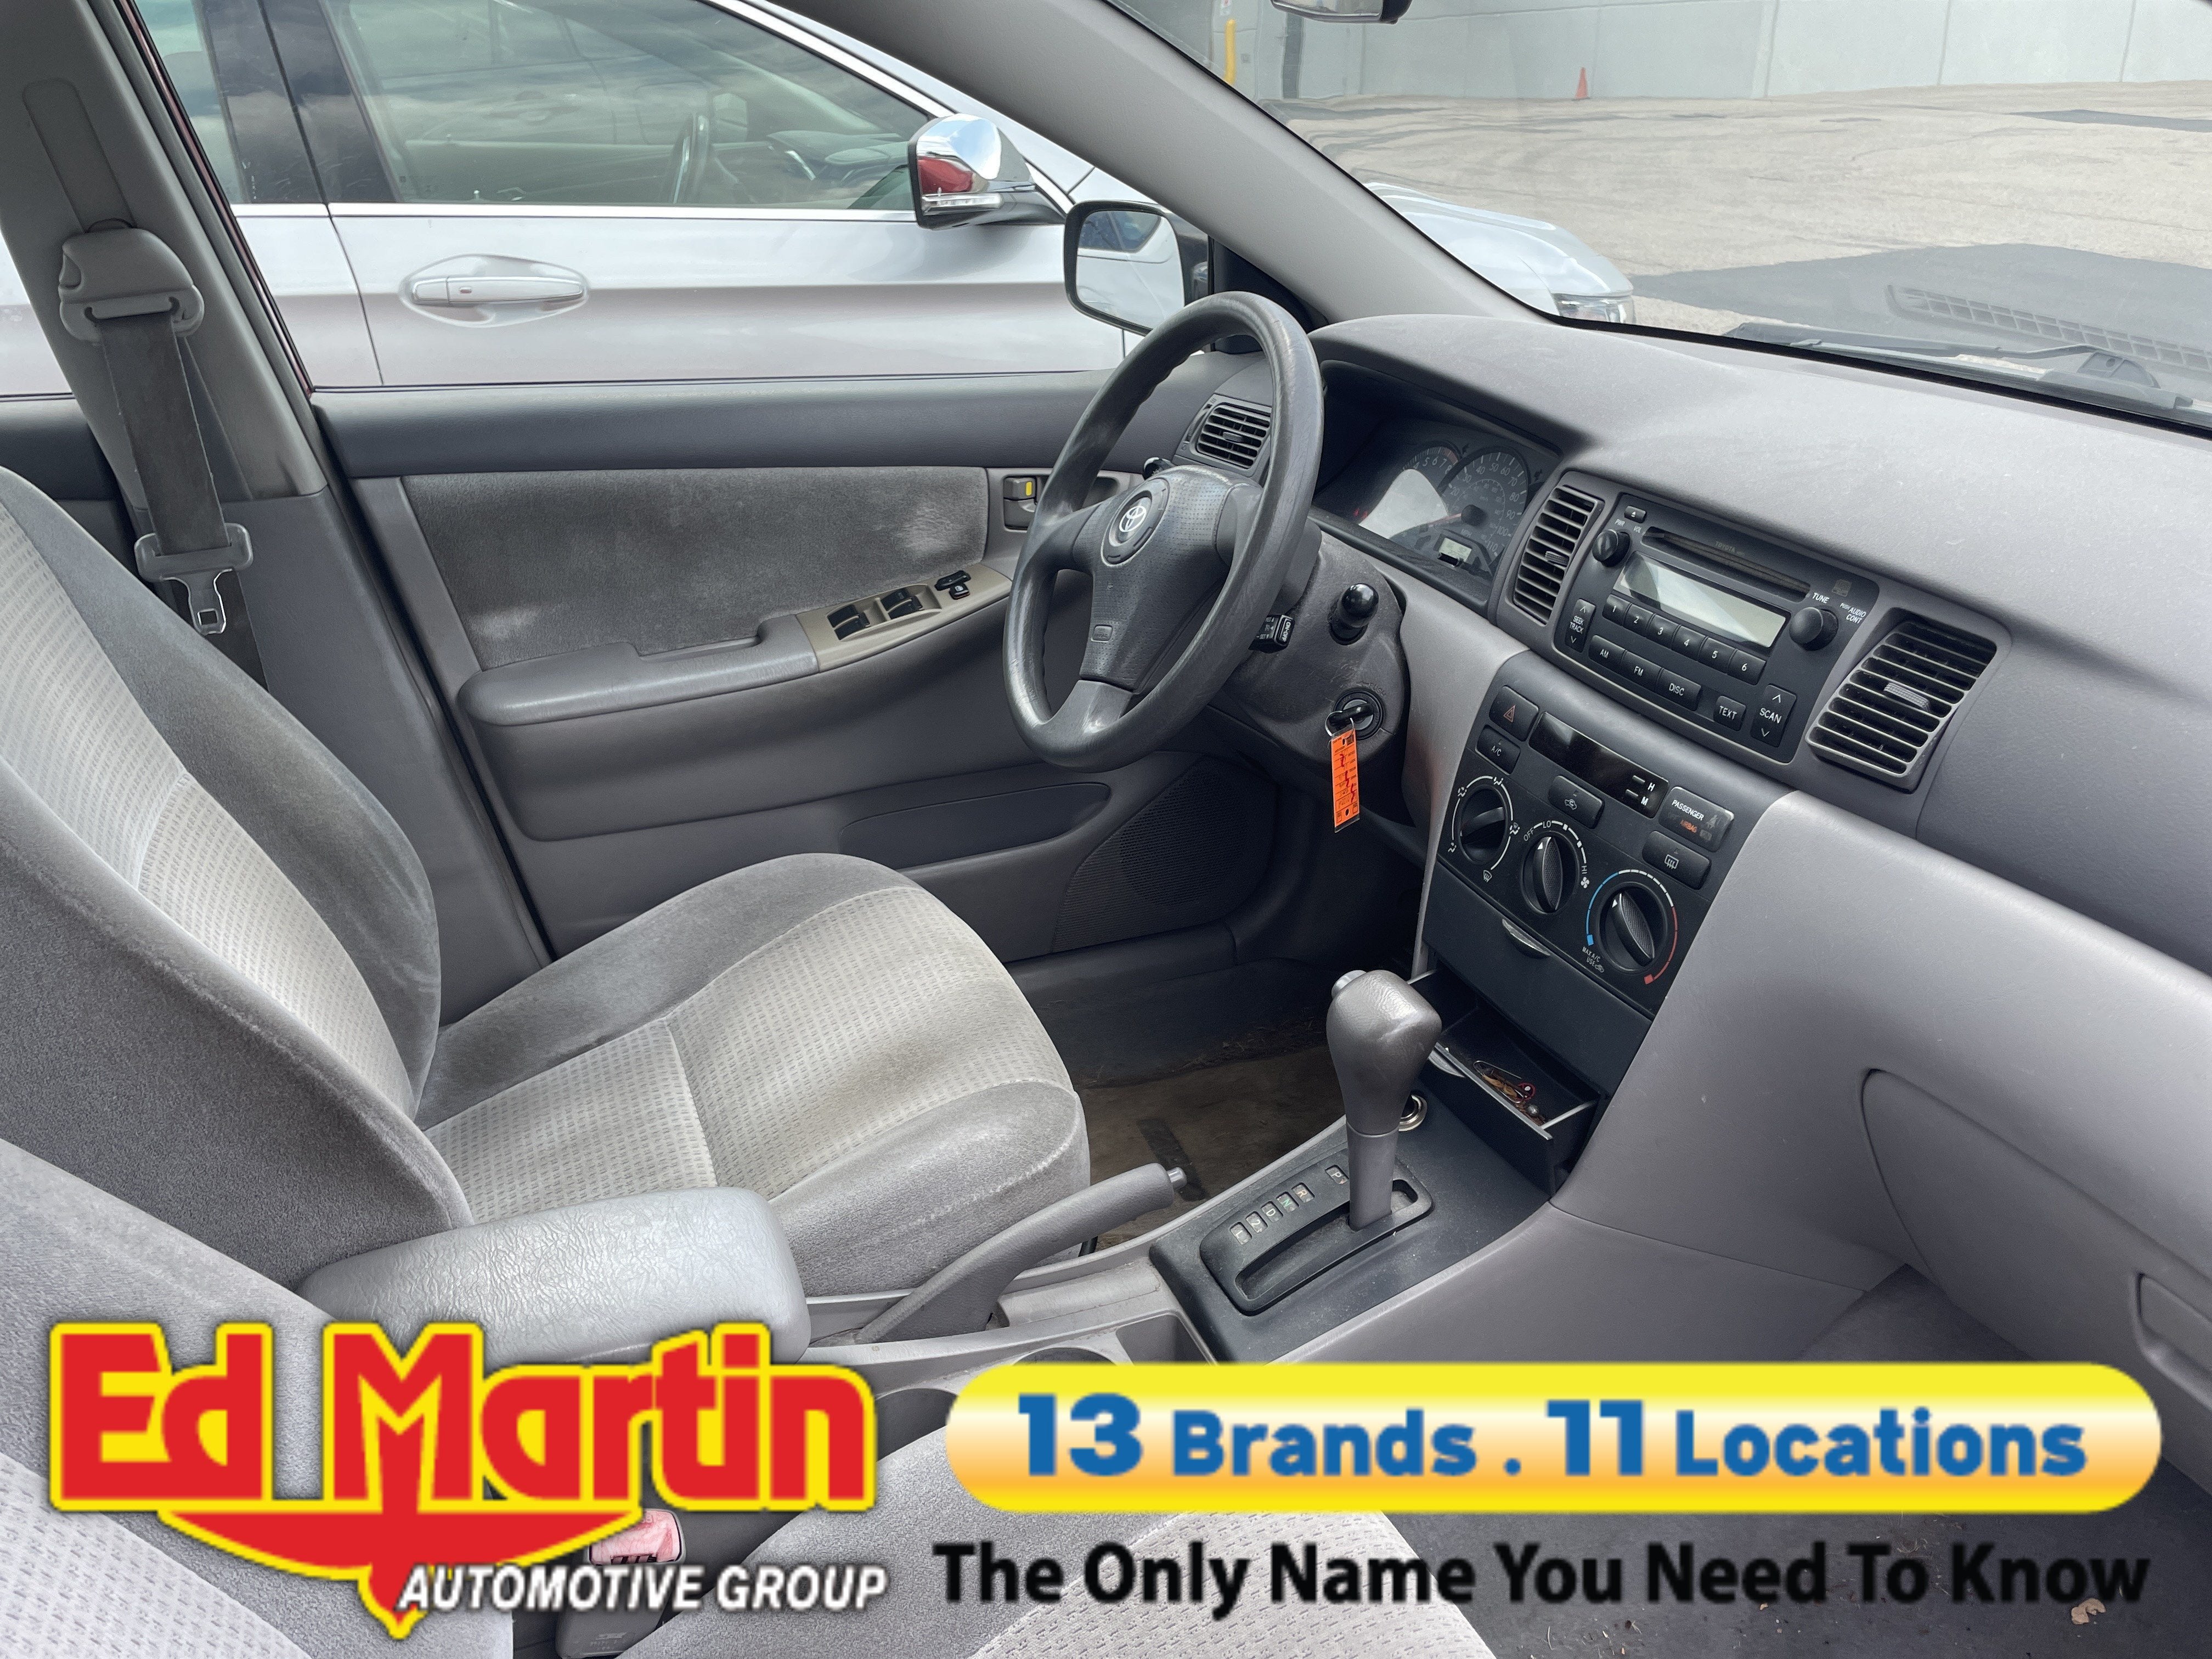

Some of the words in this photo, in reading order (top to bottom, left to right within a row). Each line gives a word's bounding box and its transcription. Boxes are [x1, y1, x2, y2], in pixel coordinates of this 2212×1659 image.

[1432, 456, 1438, 465] 6
[1476, 466, 1486, 475] 40
[1489, 462, 1499, 472] 50
[1500, 466, 1510, 476] 60
[1508, 477, 1517, 487] 70
[1509, 492, 1519, 502] 80
[1506, 510, 1515, 520] 90
[1497, 526, 1509, 537] 100
[1813, 592, 1830, 604] TUNE
[1848, 607, 1866, 618] AUDIO
[1573, 615, 1584, 625] SEEK
[1846, 613, 1863, 624] CONT
[1570, 622, 1584, 634] TRACK
[1657, 627, 1663, 635] 3
[1599, 648, 1610, 659] AM
[1711, 651, 1718, 659] 5
[1633, 665, 1644, 677] FM
[1741, 663, 1747, 672] 6
[1668, 682, 1685, 697] DISC
[1719, 705, 1737, 720] TEXT
[1759, 708, 1782, 724] SCAN
[1491, 745, 1502, 757] A/C
[1647, 783, 1656, 791] H
[1640, 797, 1649, 806] M
[1672, 799, 1705, 821] PASSENGER
[1542, 820, 1551, 829] LO
[1523, 827, 1534, 842] OFF
[1581, 865, 1588, 874] HI
[1582, 946, 1592, 956] MAX
[1591, 953, 1601, 962] A/C
[1587, 957, 1595, 967] USE
[1297, 1189, 1308, 1198] R
[1283, 1199, 1292, 1207] N
[1266, 1208, 1276, 1217] D
[1250, 1219, 1260, 1227] 2
[1235, 1230, 1243, 1239] L
